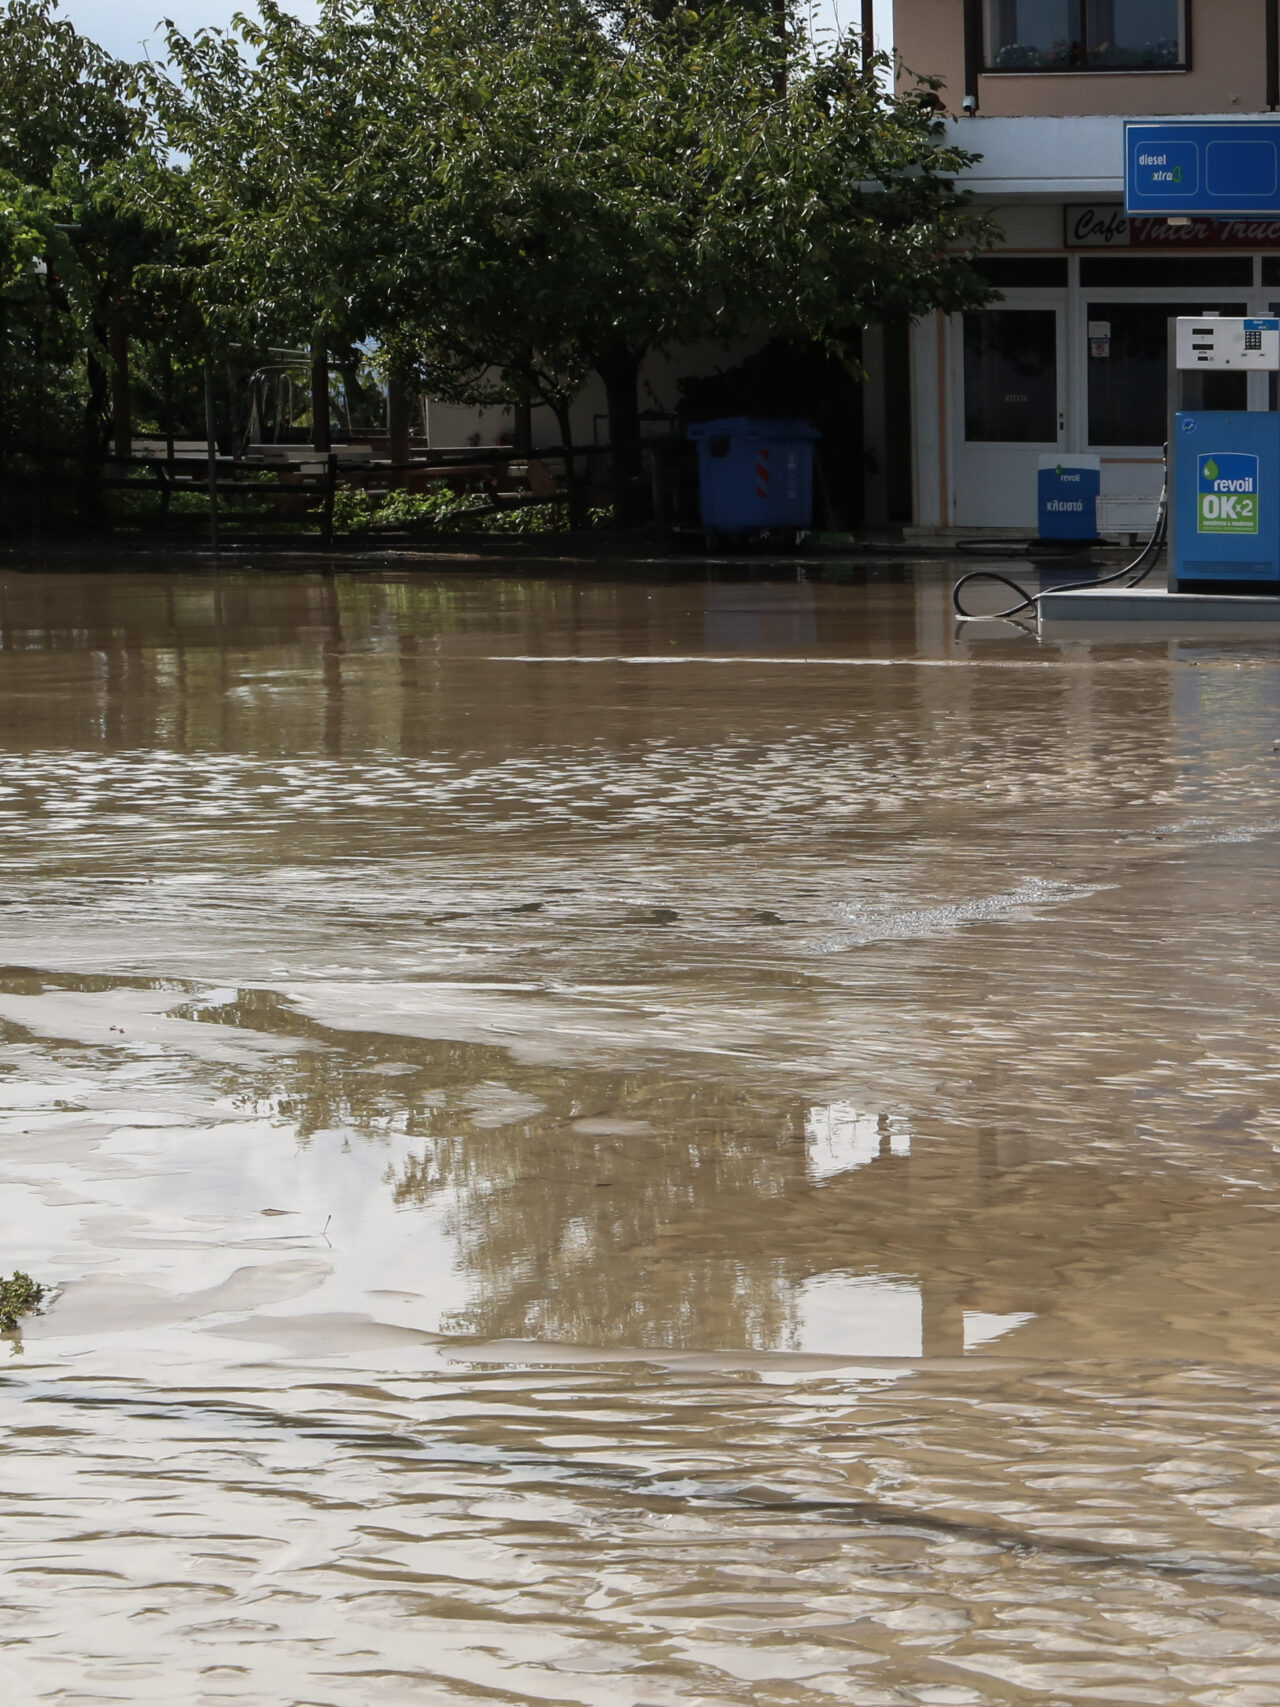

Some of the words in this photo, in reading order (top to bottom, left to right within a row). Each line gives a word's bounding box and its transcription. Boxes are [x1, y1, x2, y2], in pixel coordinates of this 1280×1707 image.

[1138, 154, 1166, 166] diesel
[1074, 209, 1127, 242] Cafe
[1060, 473, 1081, 482] revoil
[1213, 477, 1254, 493] revoil
[1046, 499, 1084, 512] κλειστό
